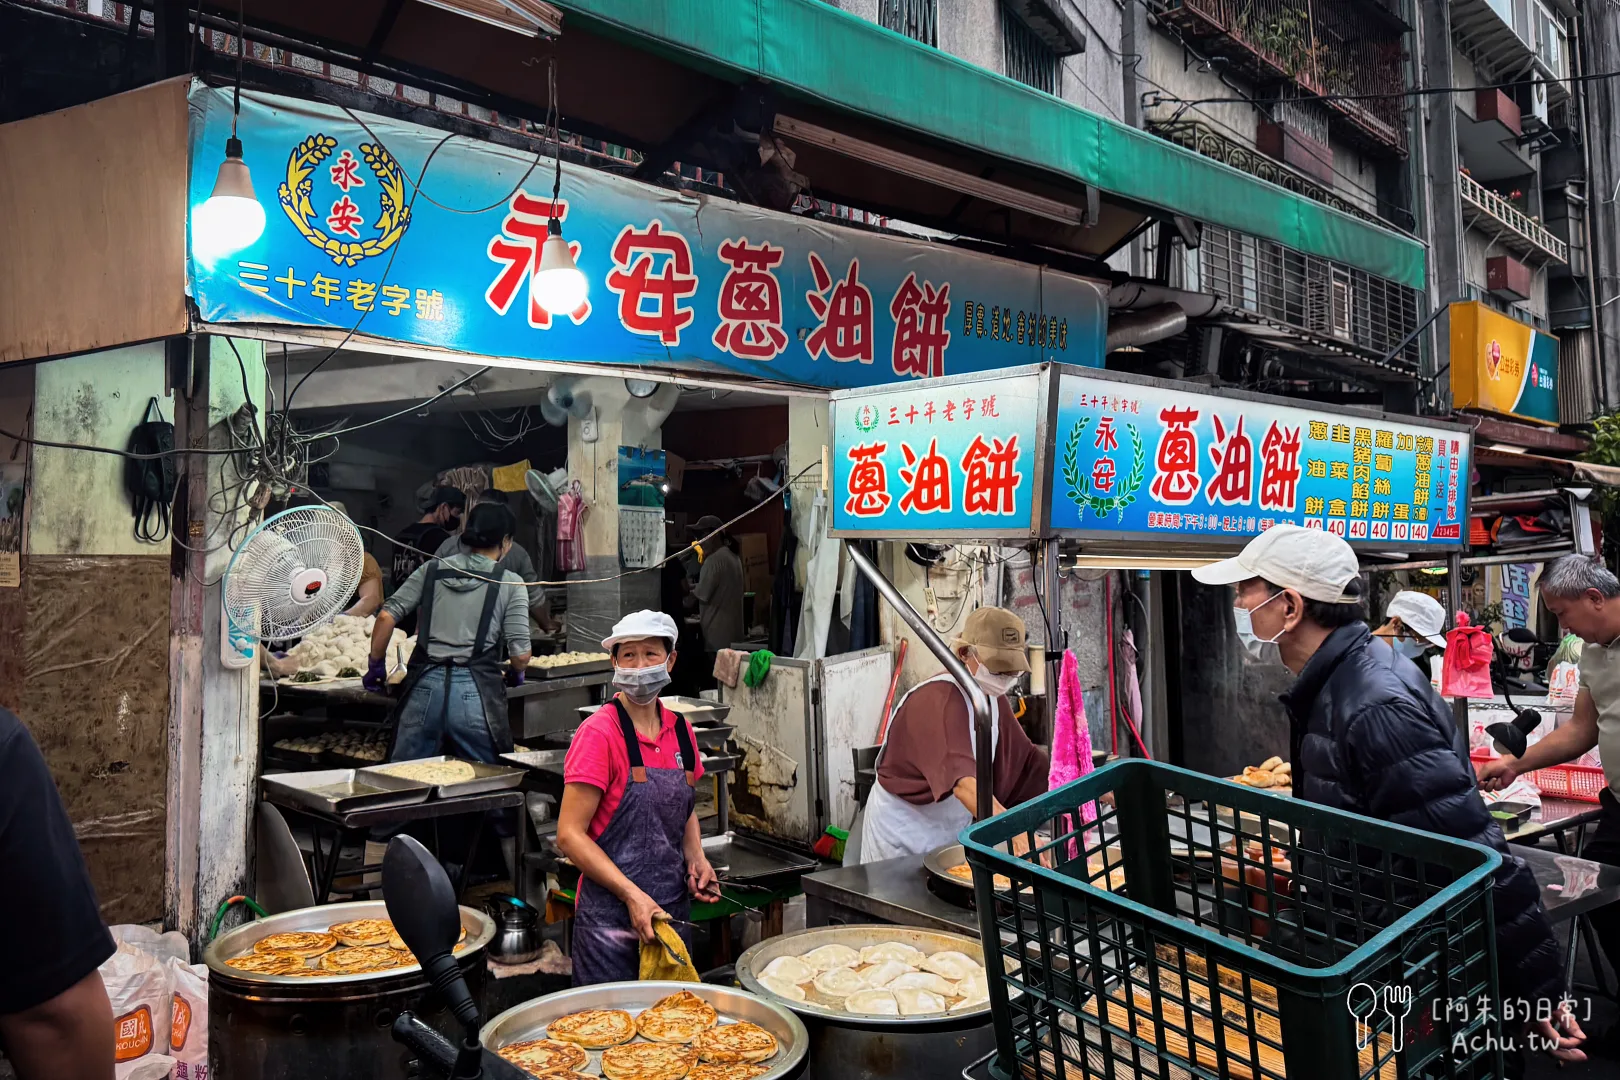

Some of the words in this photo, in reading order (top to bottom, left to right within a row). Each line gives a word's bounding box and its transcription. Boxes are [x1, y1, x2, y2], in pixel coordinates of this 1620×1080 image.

[326, 150, 365, 238] 永安
[238, 261, 445, 320] 三十年老字號
[887, 394, 1000, 426] 三十年老字號
[845, 434, 1021, 515] 蔥油餅
[1091, 416, 1119, 492] 永安
[1150, 405, 1302, 511] 蔥油餅
[1304, 420, 1328, 515] 蔥油餅
[1328, 424, 1350, 517] 韭菜盒
[1393, 432, 1413, 520] 加蛋
[1328, 520, 1345, 536] 40
[1351, 521, 1367, 537] 40
[1372, 522, 1388, 538] 40
[1394, 524, 1406, 538] 10
[1411, 525, 1427, 539] 140
